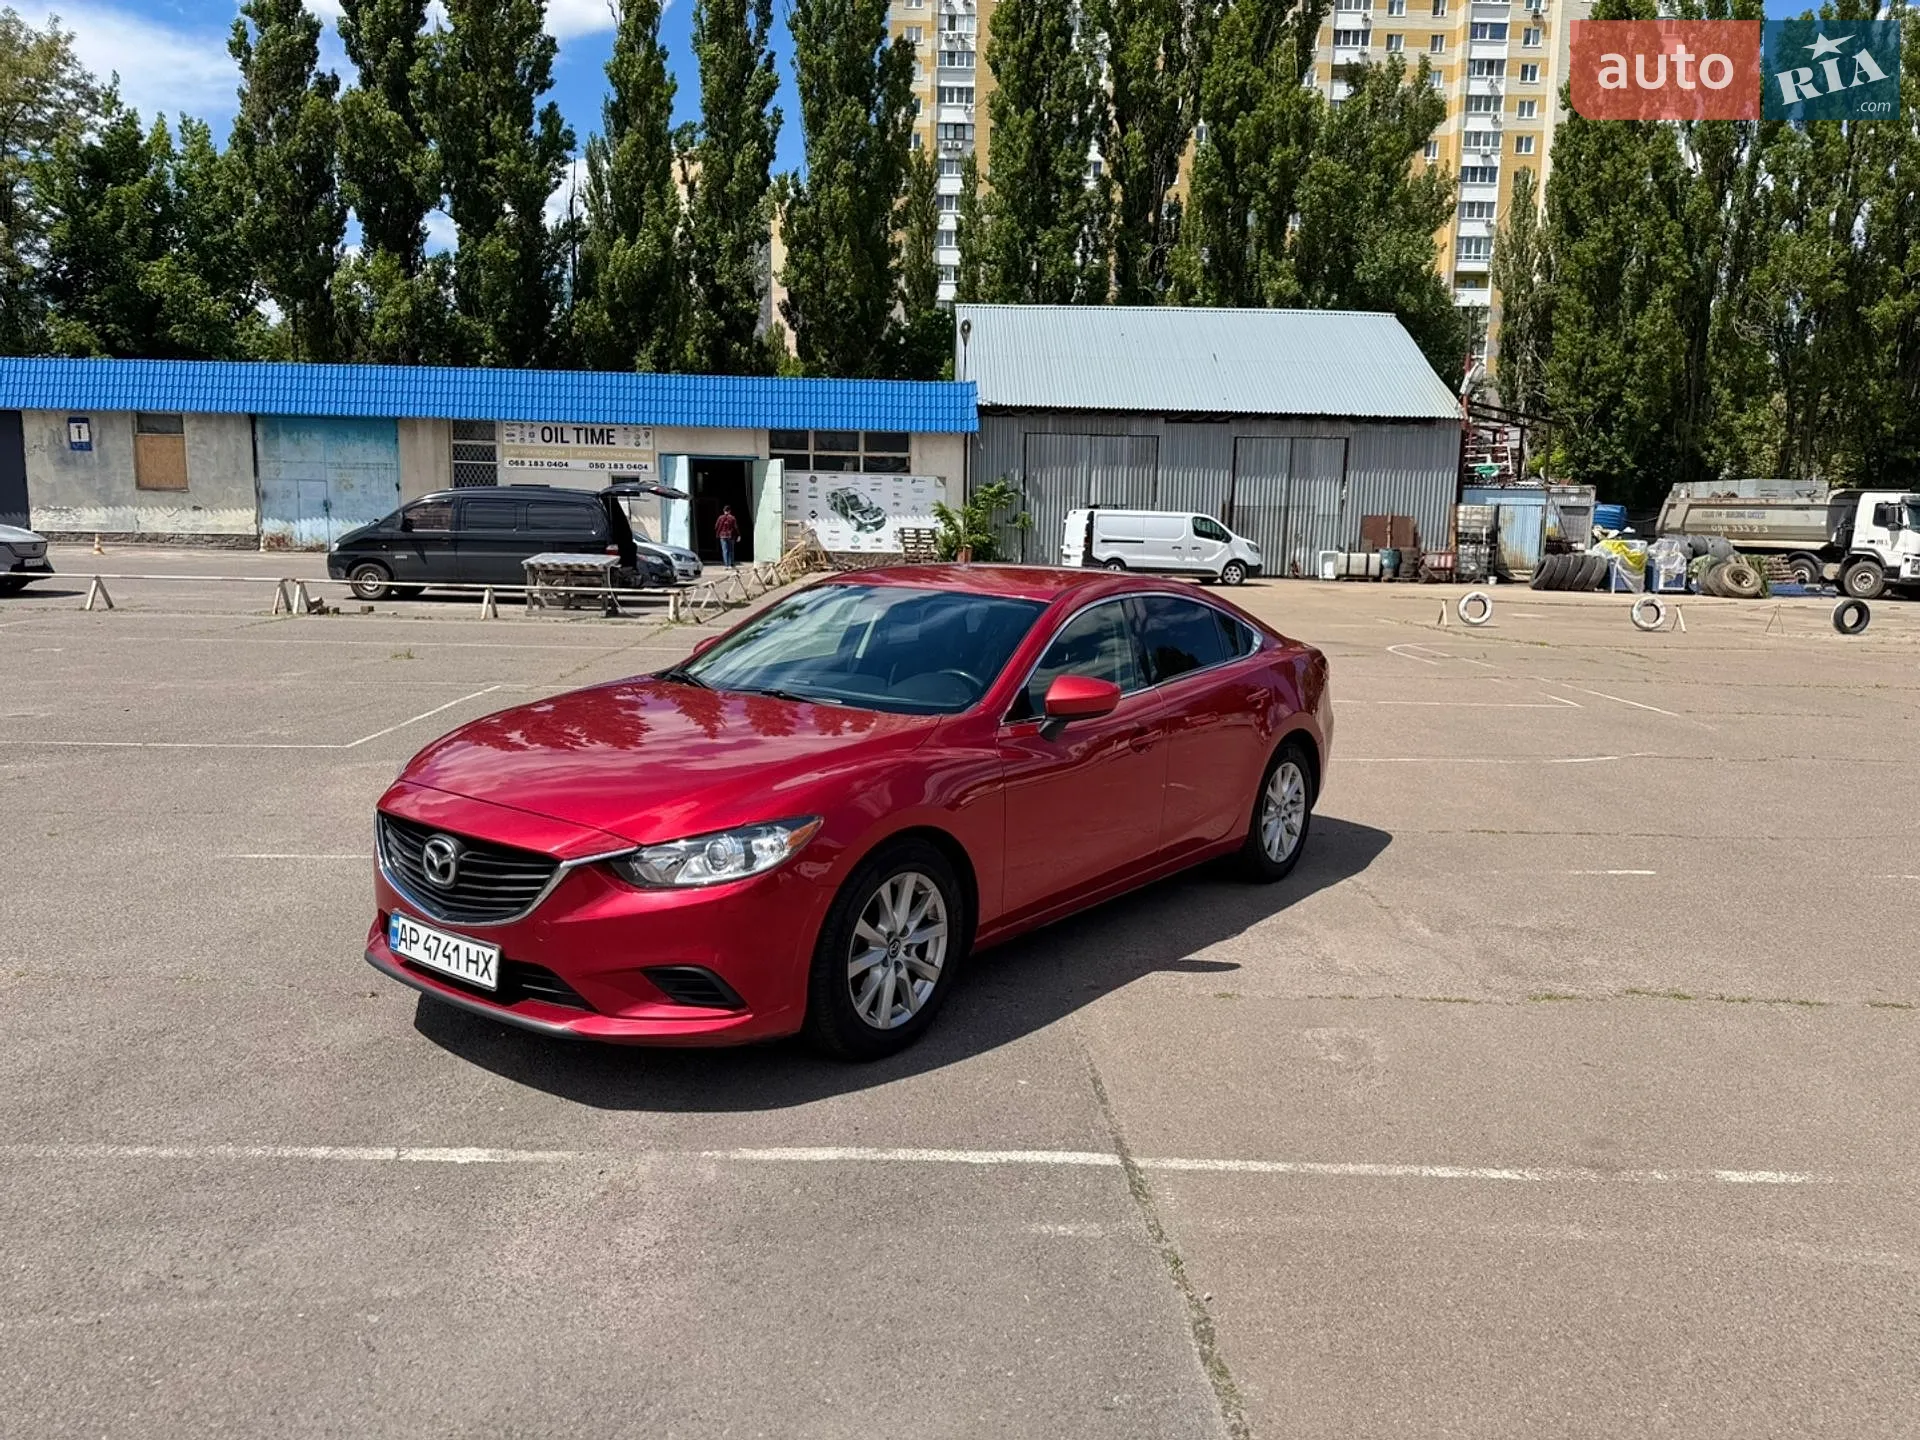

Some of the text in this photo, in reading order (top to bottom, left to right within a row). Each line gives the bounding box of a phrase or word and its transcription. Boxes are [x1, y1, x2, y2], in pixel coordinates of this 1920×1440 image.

[541, 426, 570, 443] OIL
[573, 427, 616, 445] TIME
[508, 459, 526, 467] 068
[588, 462, 606, 470] 050
[626, 463, 649, 471] 0404
[399, 923, 493, 981] AP 4741 HX
